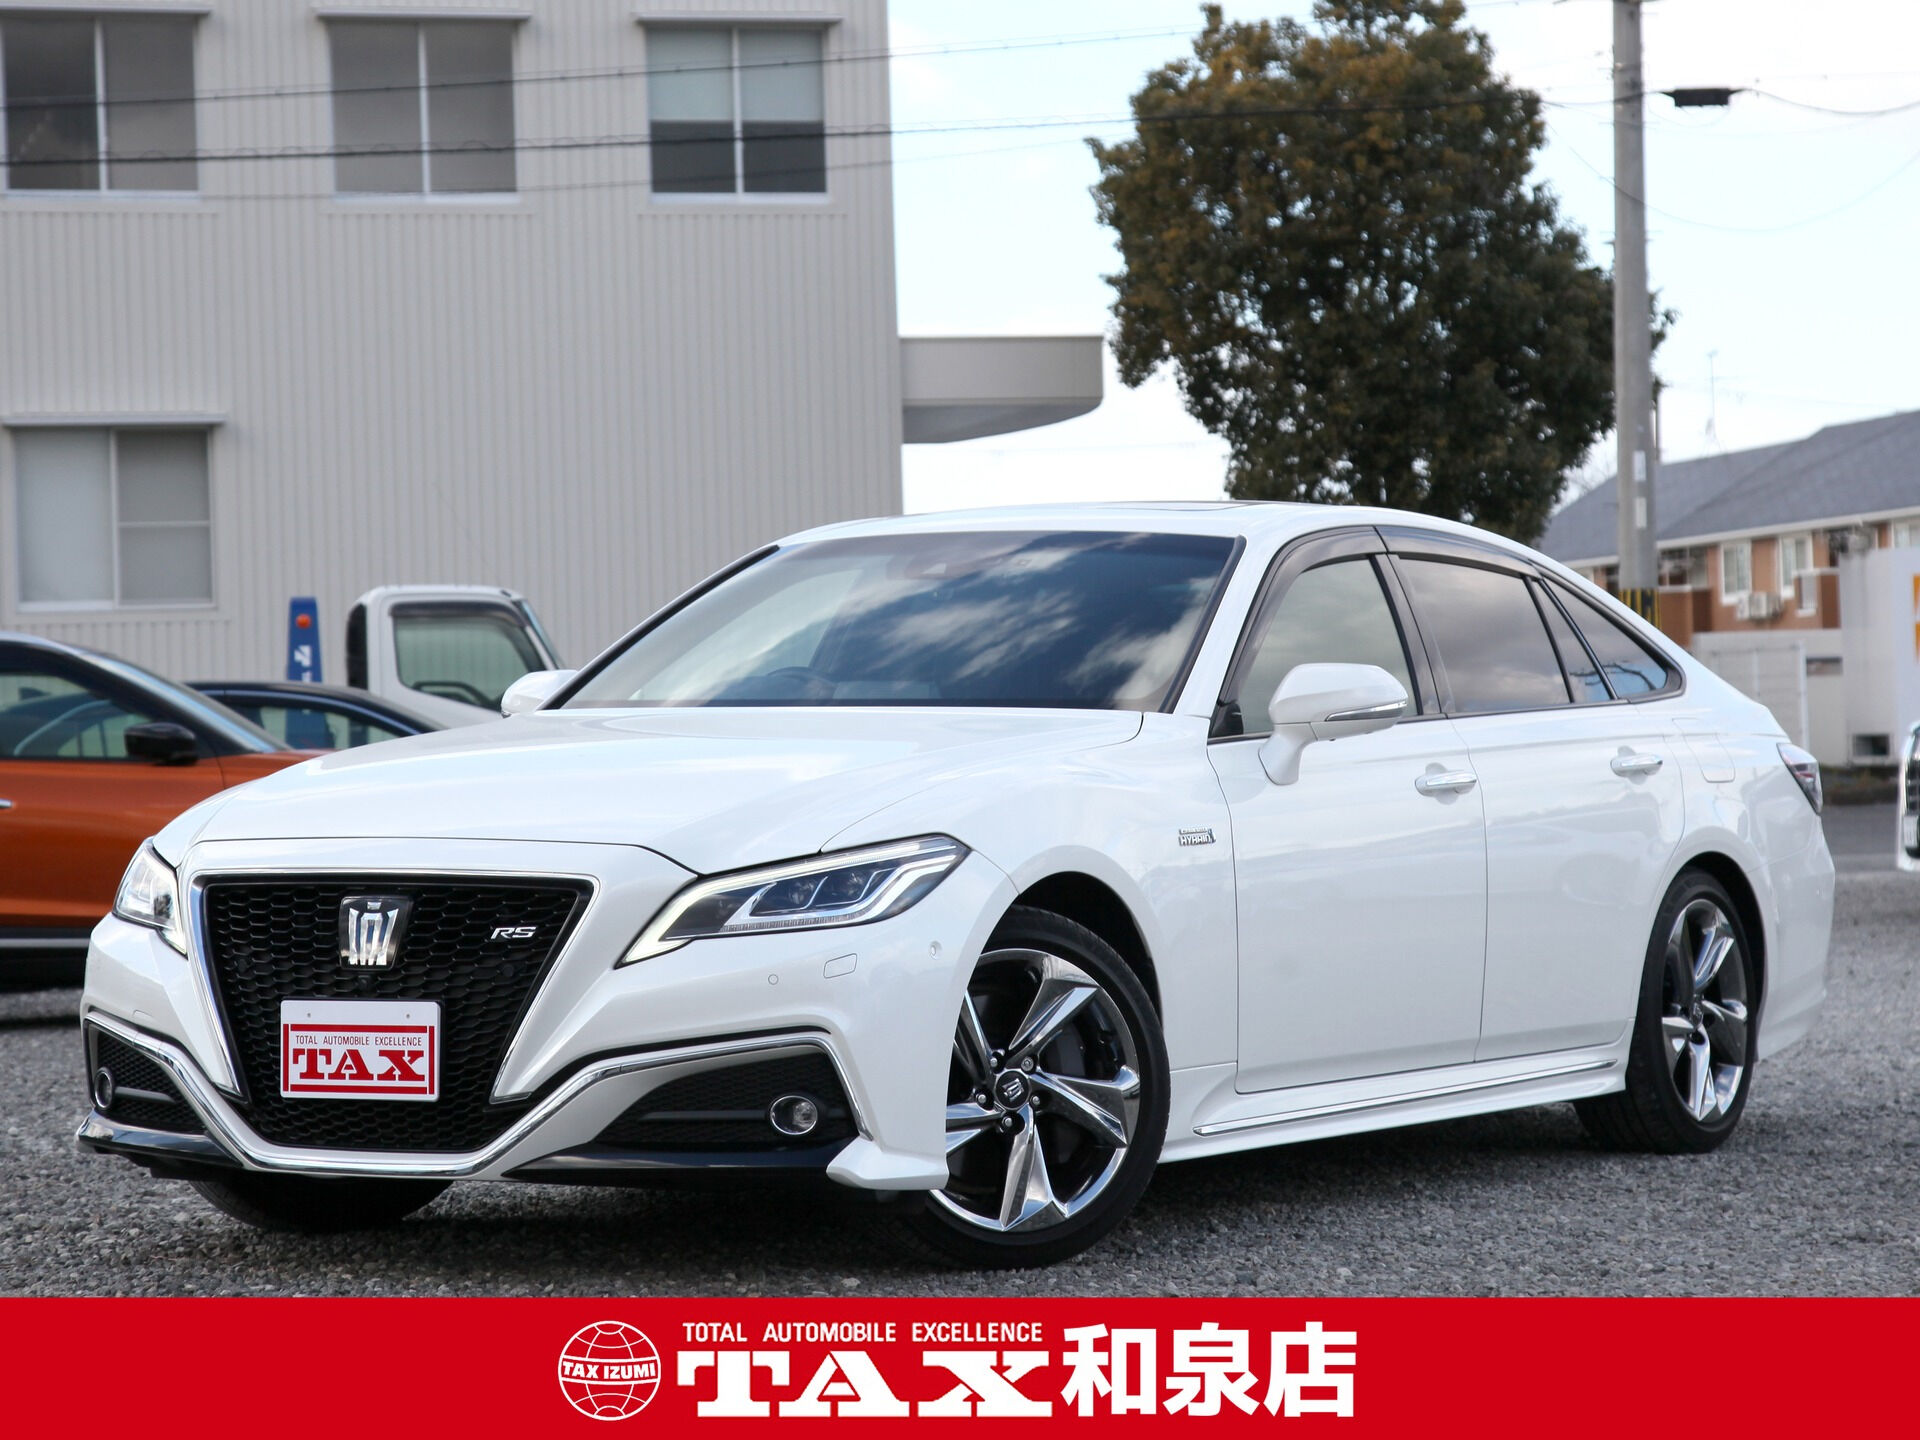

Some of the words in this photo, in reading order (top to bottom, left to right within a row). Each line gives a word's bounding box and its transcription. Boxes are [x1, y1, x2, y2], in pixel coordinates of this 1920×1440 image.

[490, 926, 537, 940] RS
[295, 1035, 318, 1045] TOTAL
[323, 1035, 370, 1046] AUTOMOBILE
[374, 1036, 422, 1047] EXCELLENCE
[292, 1047, 426, 1082] TAX
